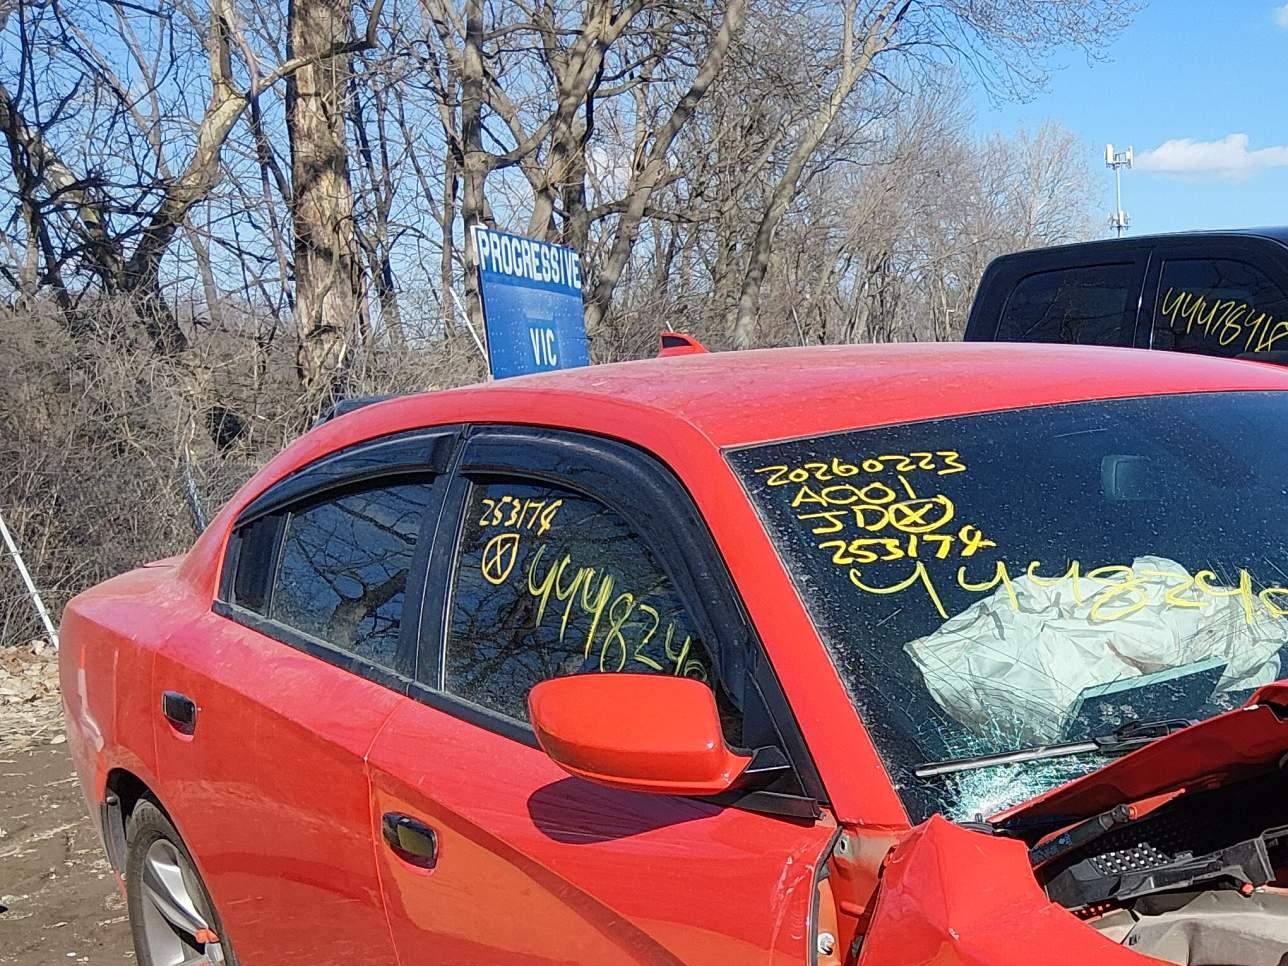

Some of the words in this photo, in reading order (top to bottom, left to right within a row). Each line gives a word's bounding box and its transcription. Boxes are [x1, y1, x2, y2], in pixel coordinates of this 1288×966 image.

[477, 229, 582, 290] PROGRESSIVE
[529, 327, 558, 366] VIC
[754, 451, 967, 486] 20260223
